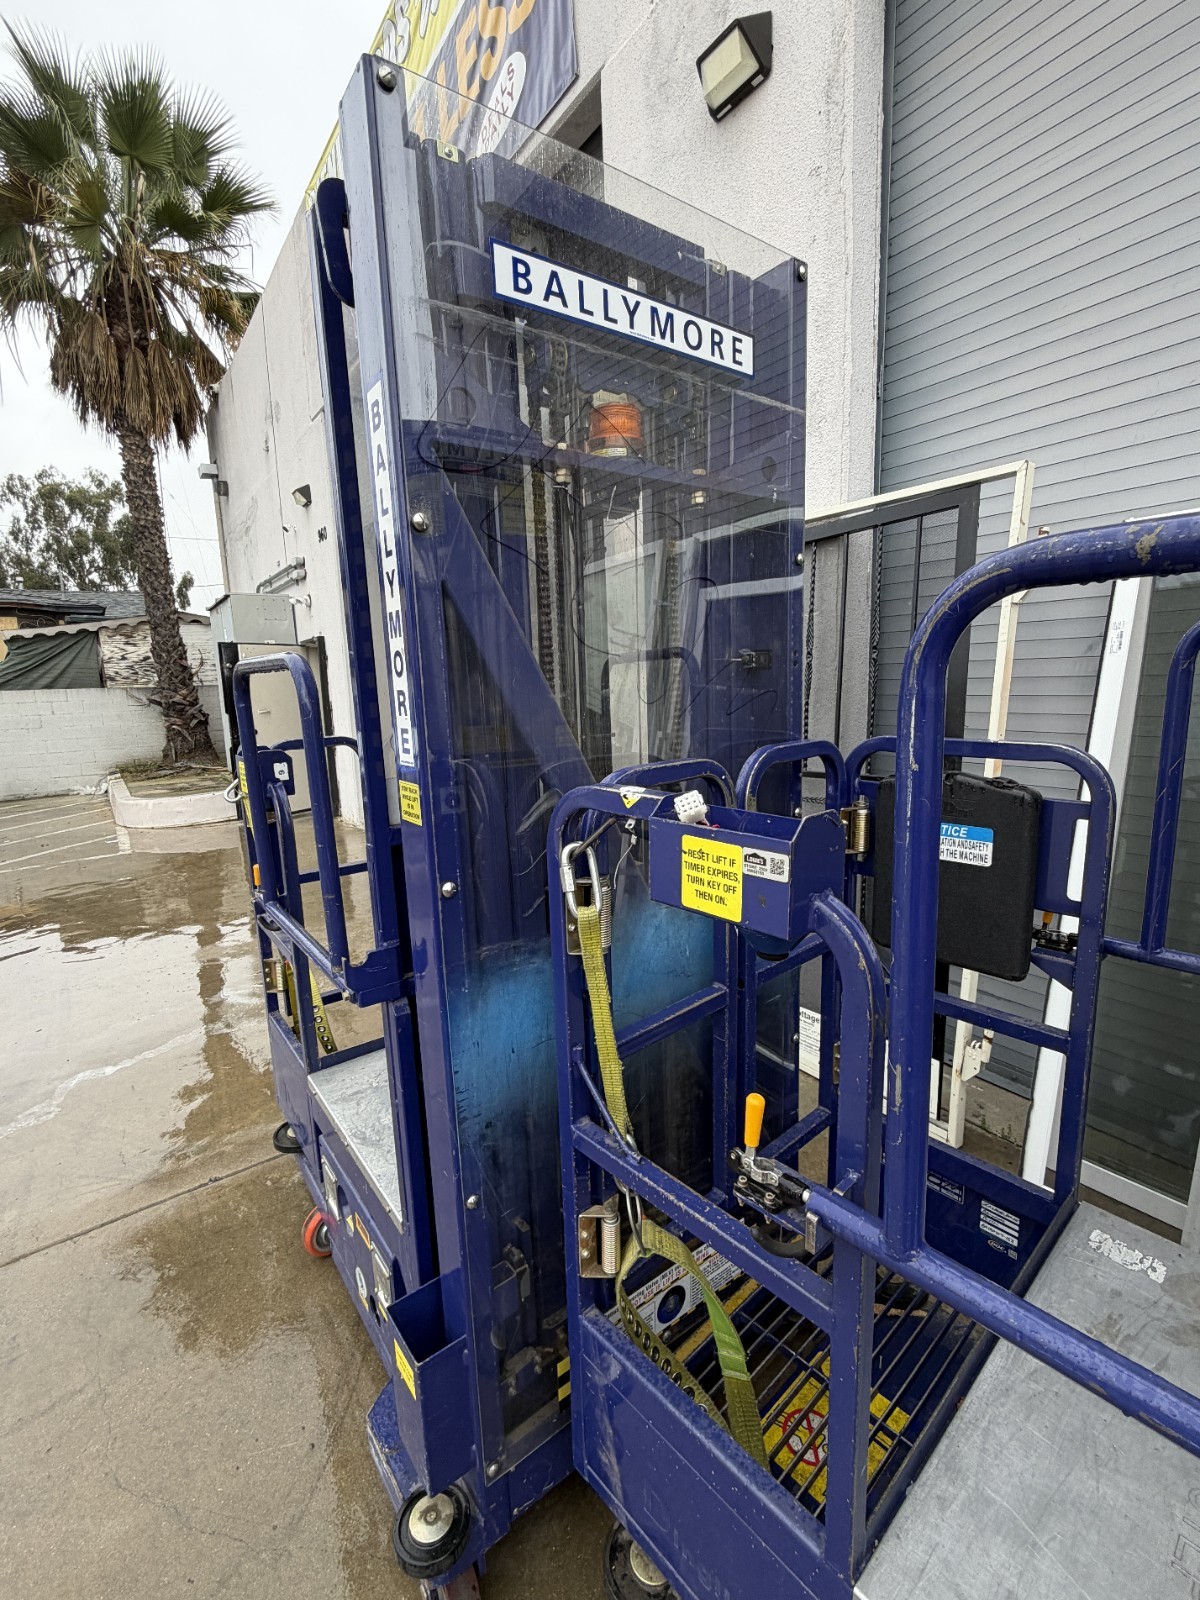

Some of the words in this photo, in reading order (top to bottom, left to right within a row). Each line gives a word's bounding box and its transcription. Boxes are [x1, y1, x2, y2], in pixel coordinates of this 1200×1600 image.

[511, 255, 743, 367] BALLYMORE
[371, 398, 411, 755] BALLYMORE
[687, 848, 710, 861] RESET
[712, 854, 728, 866] LIFT
[729, 857, 737, 868] IF
[945, 849, 958, 859] THE
[959, 850, 989, 863] MACHINE
[684, 860, 706, 874] TIMER
[686, 873, 705, 887] TURN
[706, 879, 721, 891] KEY
[722, 883, 738, 895] OFF
[694, 888, 713, 902] THEN
[643, 1287, 655, 1300] USE
[655, 1283, 661, 1291] IF
[662, 1274, 674, 1286] LIFT
[675, 1269, 681, 1277] IS
